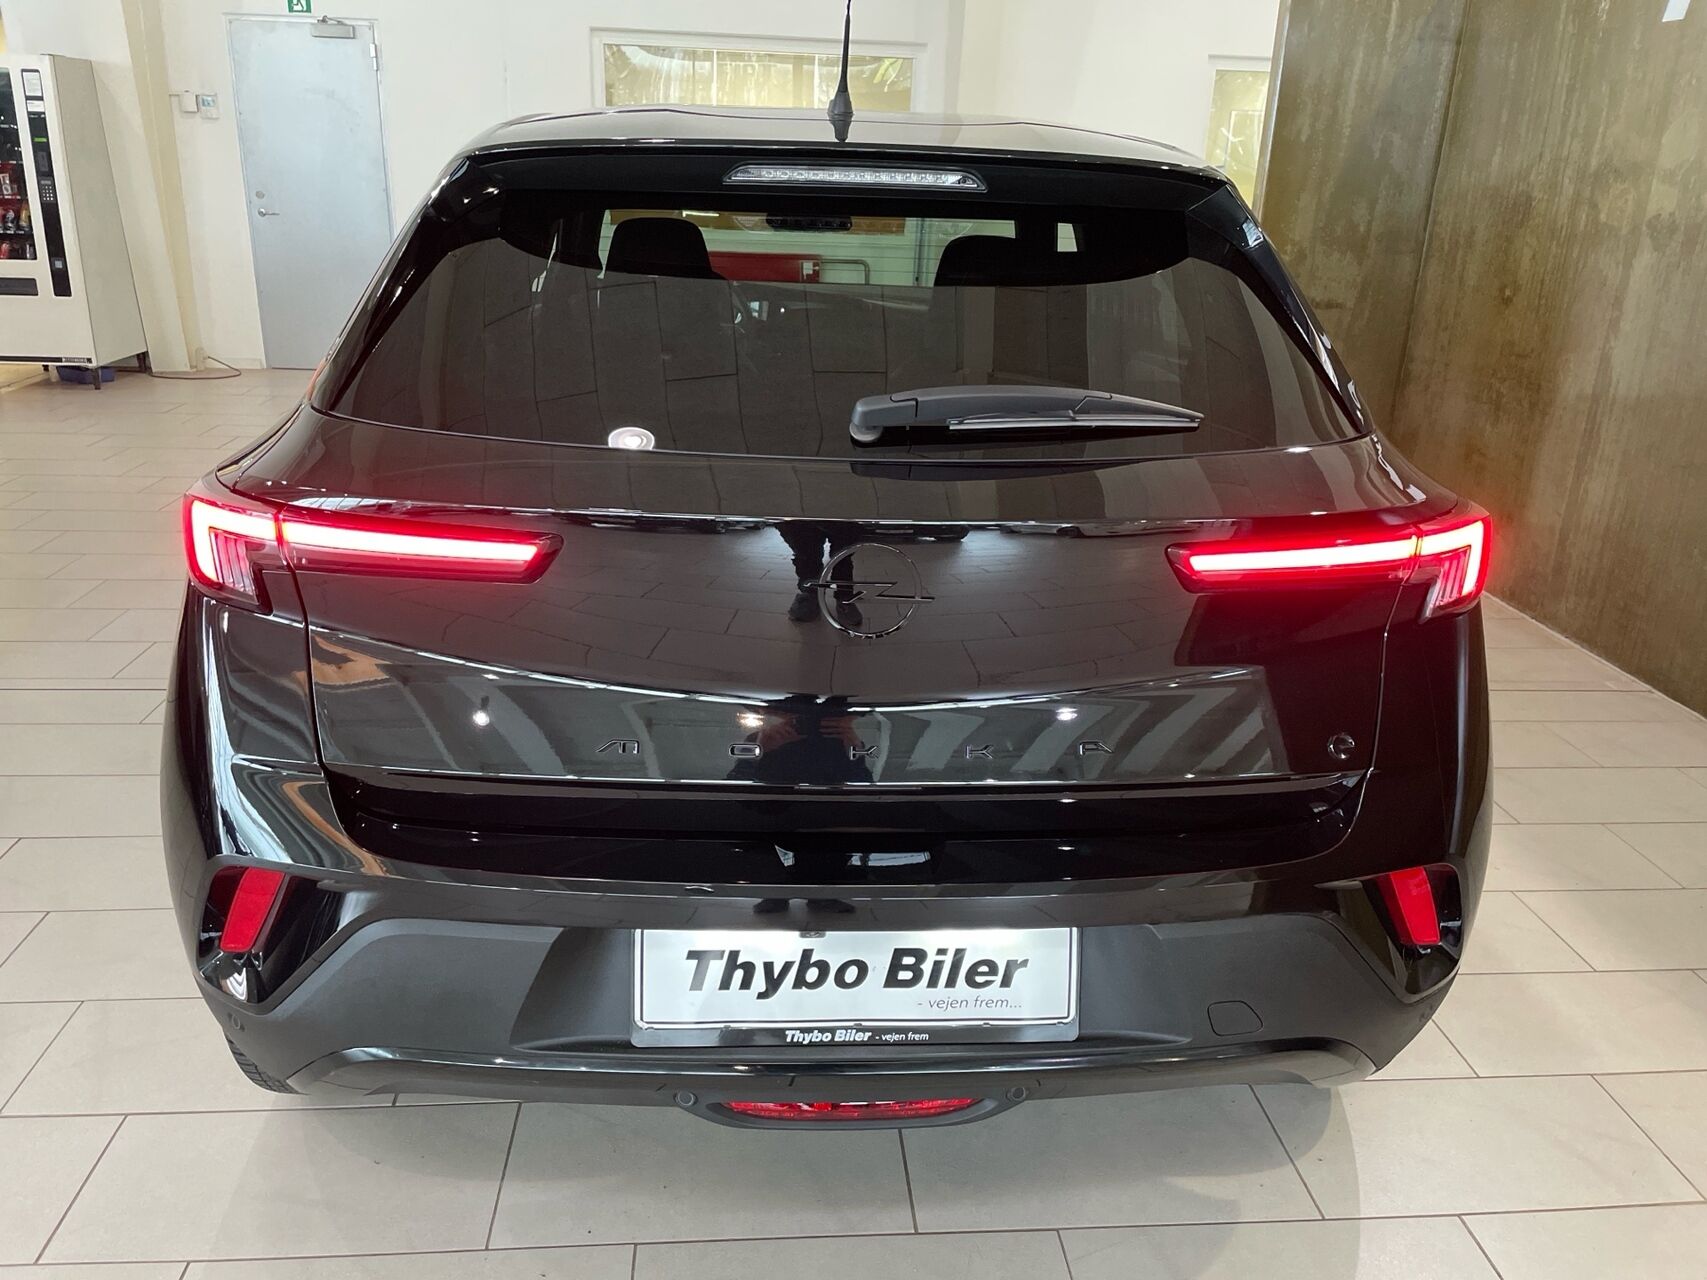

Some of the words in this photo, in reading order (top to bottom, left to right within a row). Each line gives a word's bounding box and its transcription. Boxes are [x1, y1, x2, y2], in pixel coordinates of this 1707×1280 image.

[597, 739, 1114, 759] MOKKA
[685, 948, 869, 1000] Thybo
[883, 947, 1029, 990] Biler
[928, 996, 969, 1011] vejen
[785, 1030, 832, 1044] Thybo
[834, 1029, 872, 1042] Biler
[881, 1031, 906, 1042] vejen
[907, 1031, 929, 1041] frem
